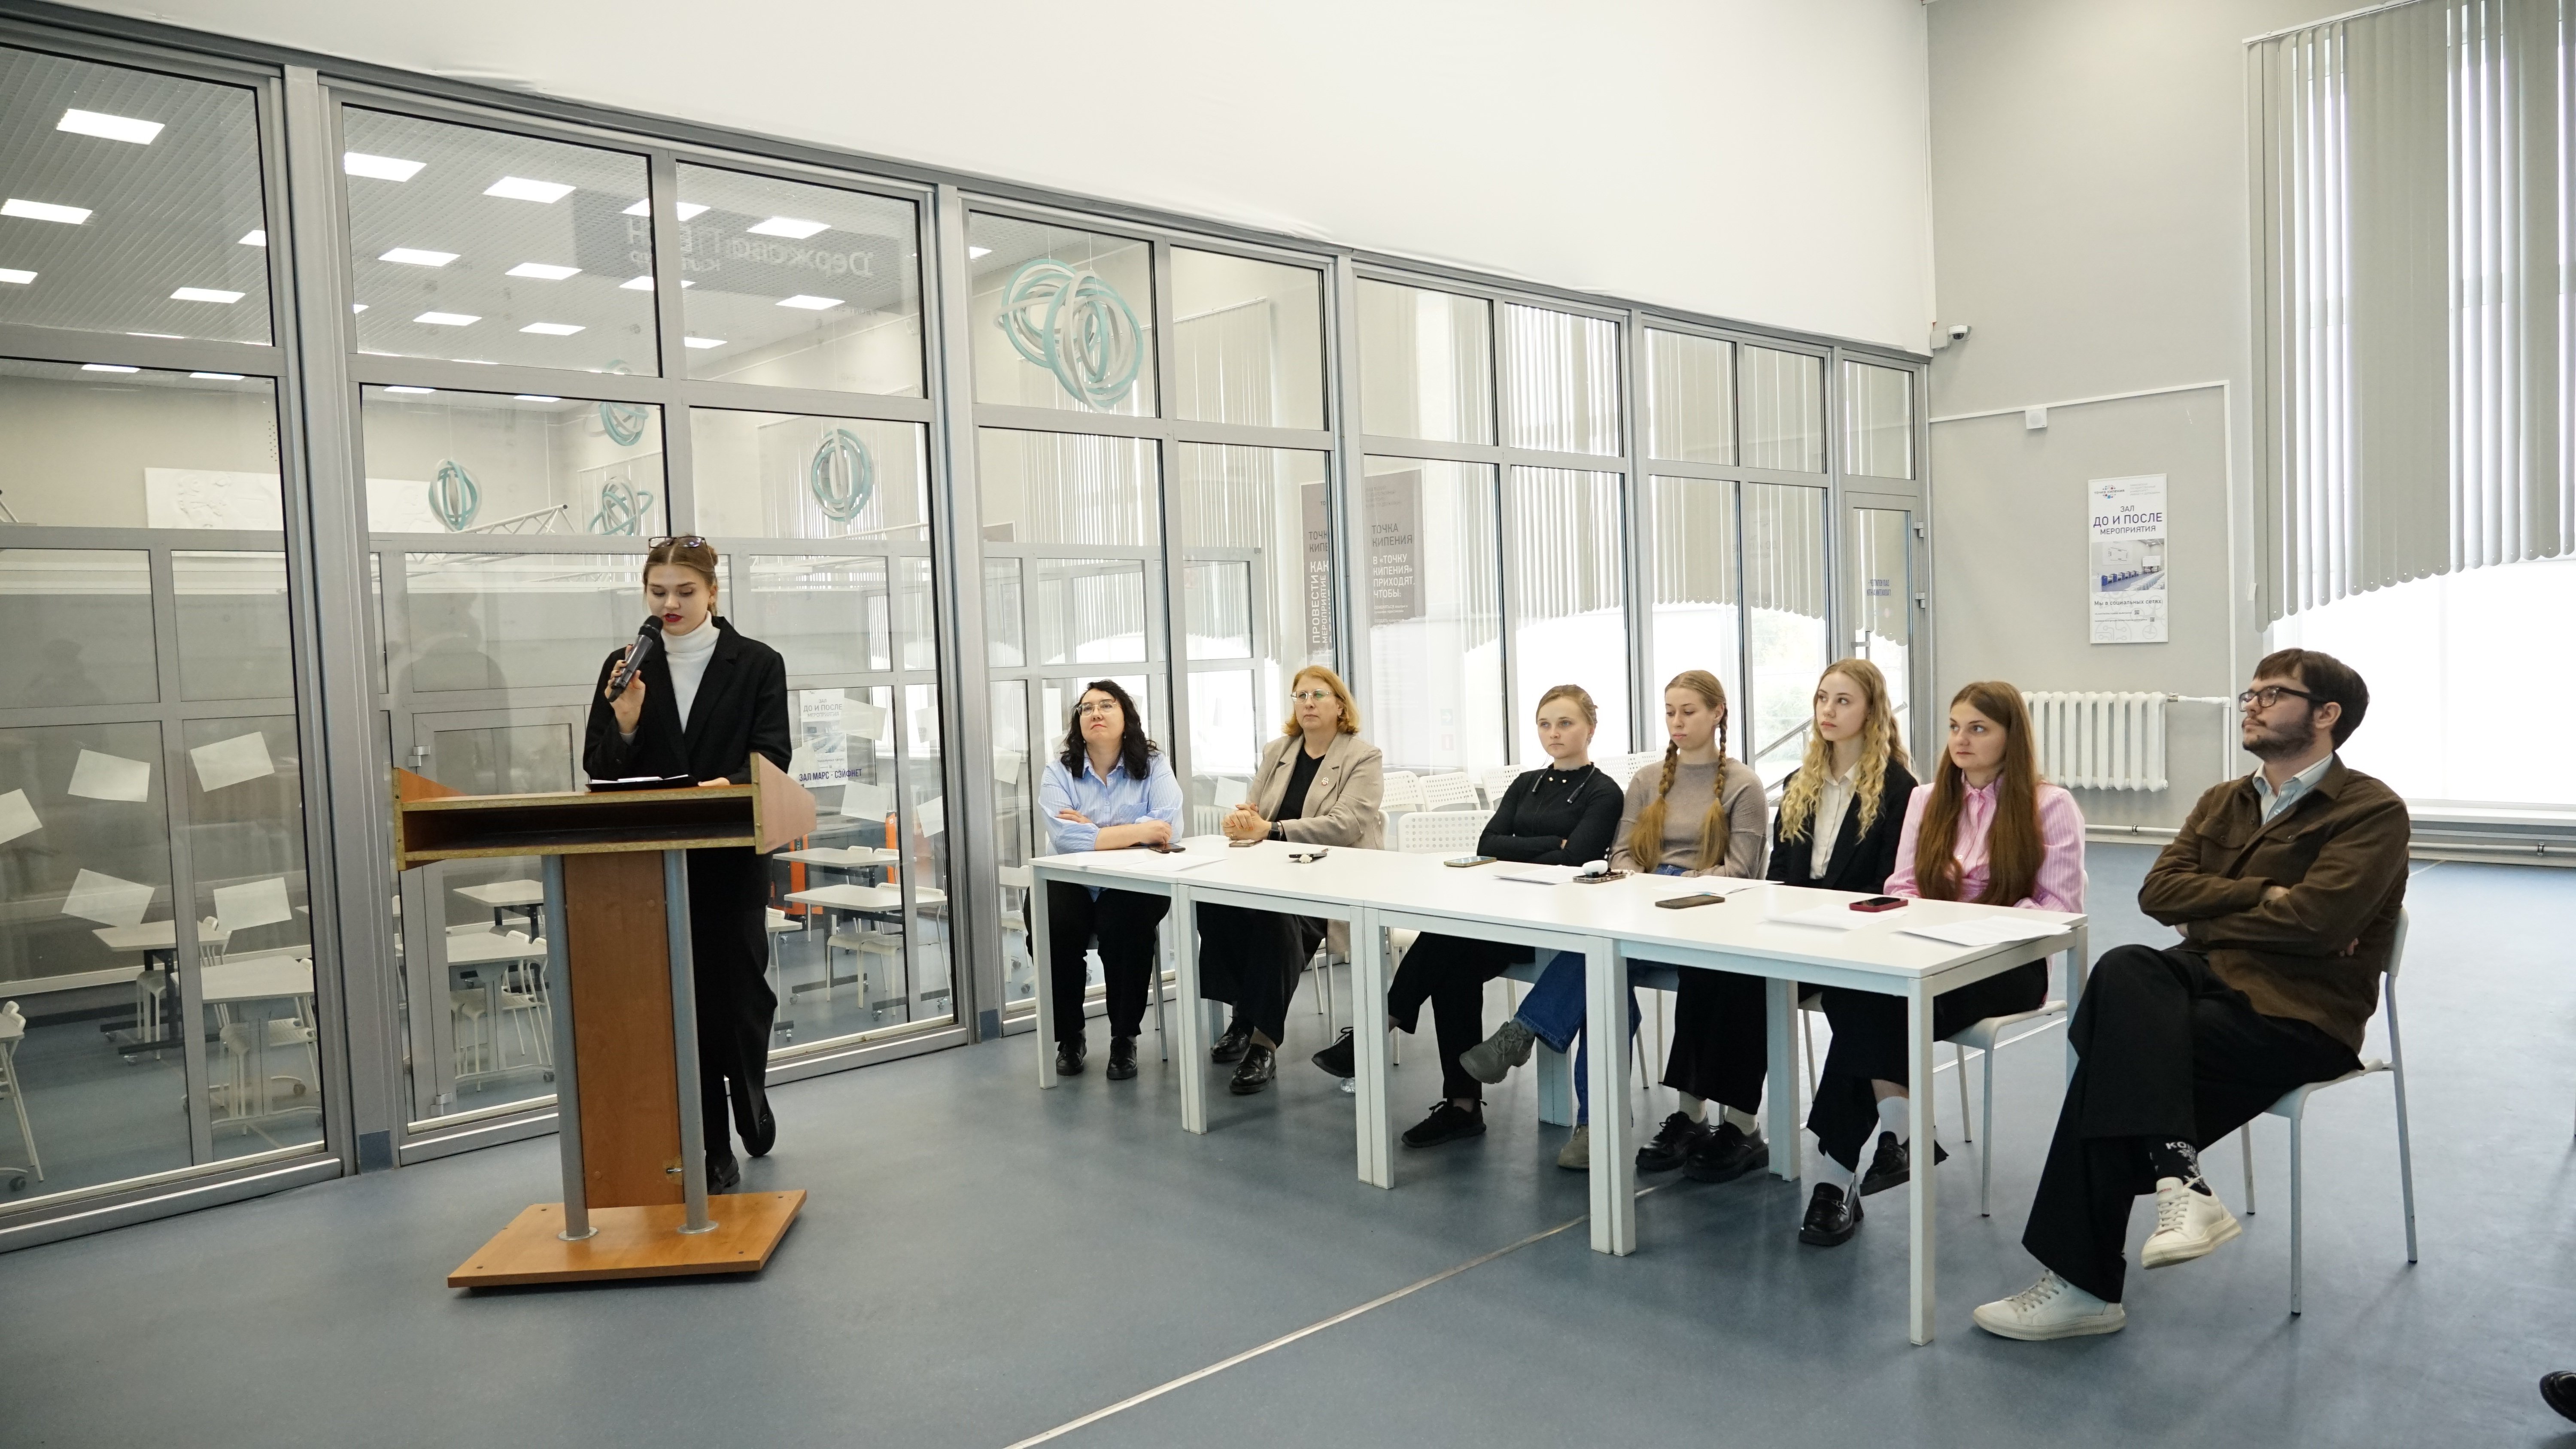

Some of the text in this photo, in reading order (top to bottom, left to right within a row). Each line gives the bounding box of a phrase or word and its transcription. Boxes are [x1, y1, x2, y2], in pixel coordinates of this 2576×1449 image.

[2093, 512, 2163, 527] ДО И ПОСЛЕ
[1372, 523, 1398, 535] ТОЧКА
[2100, 525, 2156, 535] МЕРОПРИЯТИЯ
[1372, 535, 1413, 547] КИПЕНИЯ
[1373, 554, 1407, 564] В «ТОЧКУ
[1310, 560, 1329, 573] КАК
[1373, 565, 1413, 576] КИПЕНИЯ»
[1373, 576, 1416, 587] ПРИХОДЯТ,
[1374, 589, 1401, 598] ЧТОБЫ:
[1311, 575, 1321, 643] ПРОВЕСТИ
[1320, 575, 1328, 643] МЕРОПРИЯТИЕ
[813, 772, 829, 780] МАРС
[835, 769, 862, 778] СЭЙФНЕТ
